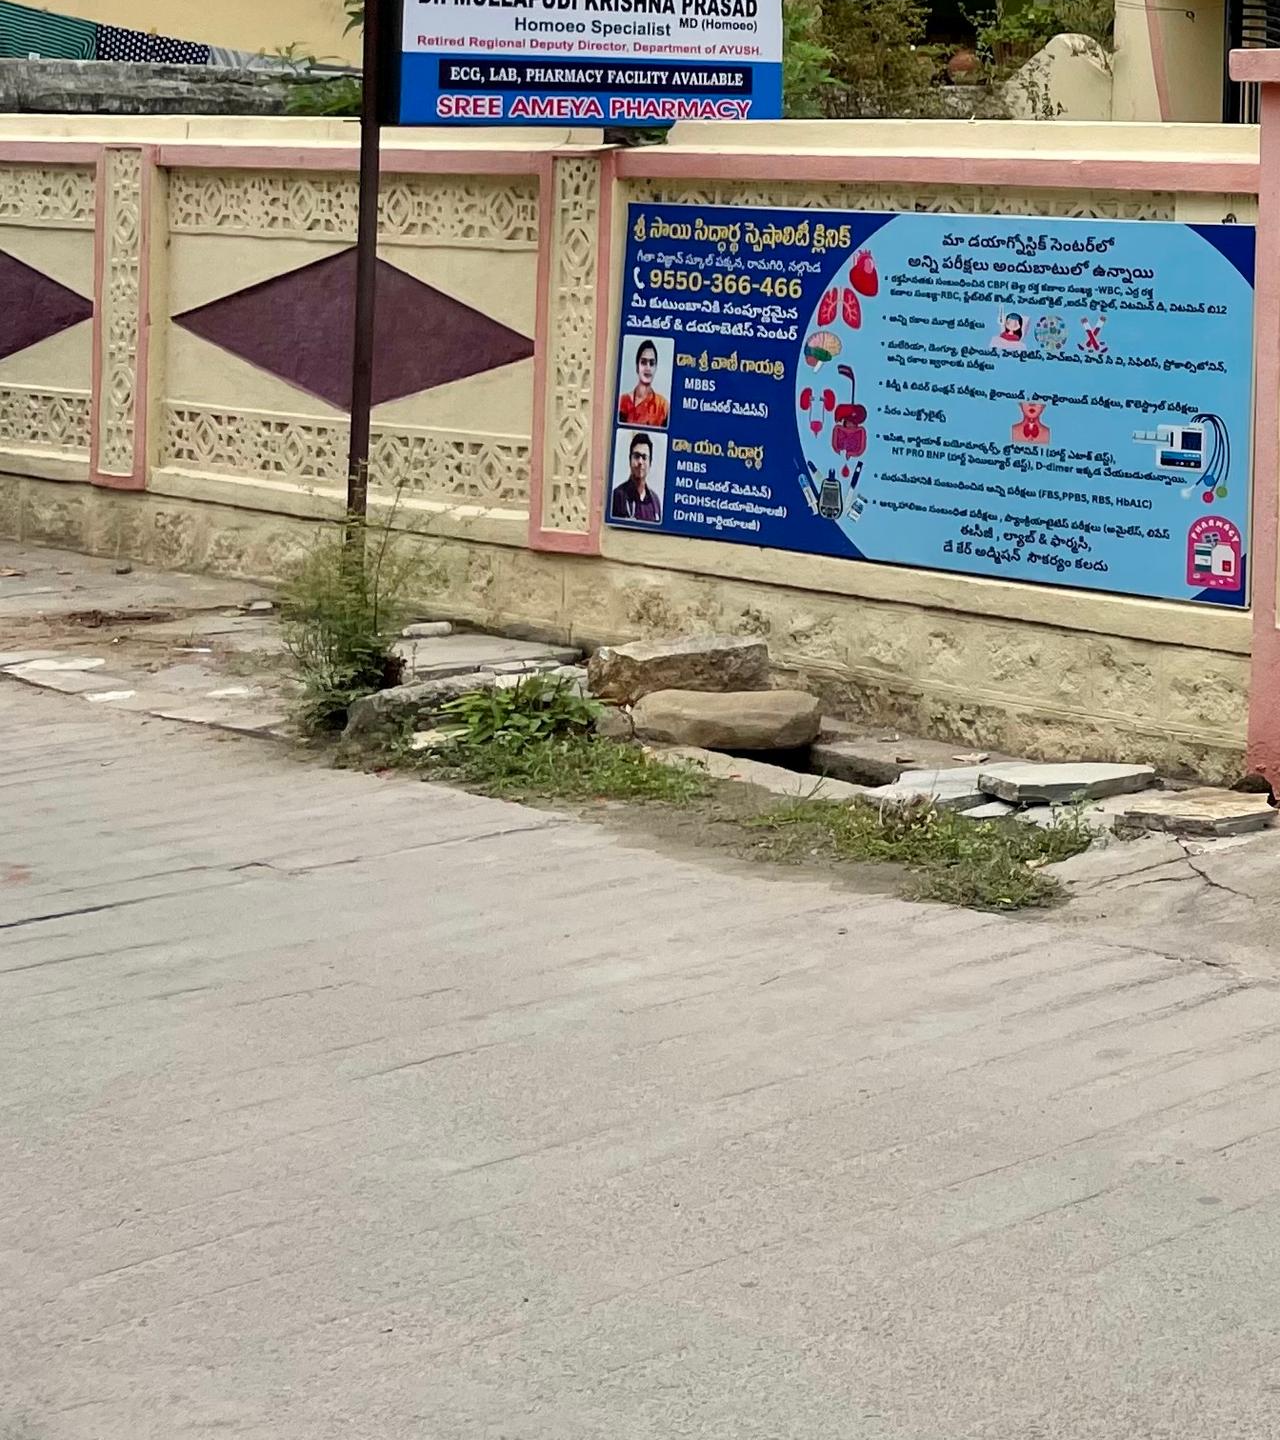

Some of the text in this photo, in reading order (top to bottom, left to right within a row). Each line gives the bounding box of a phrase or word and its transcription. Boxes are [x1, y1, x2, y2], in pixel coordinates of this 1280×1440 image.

[515, 17, 671, 36] Homoeo Specialist
[679, 18, 757, 33] MD (Homoeo)
[418, 35, 762, 56] Retired Regional Deputy Director, Department of AYUSH.
[450, 66, 743, 86] ECG, LAB, PHARMACY FACILITY AVAILABLE
[436, 94, 752, 118] SREE AMEYA PHARMACY
[633, 214, 647, 242] శ్రీ
[649, 216, 691, 241] సాయి
[694, 218, 741, 255] సిద్ధార్థ
[811, 223, 851, 253] క్లినిక్
[650, 269, 802, 298] 9550-366-466
[684, 378, 716, 392] MBBS
[683, 397, 698, 410] MD
